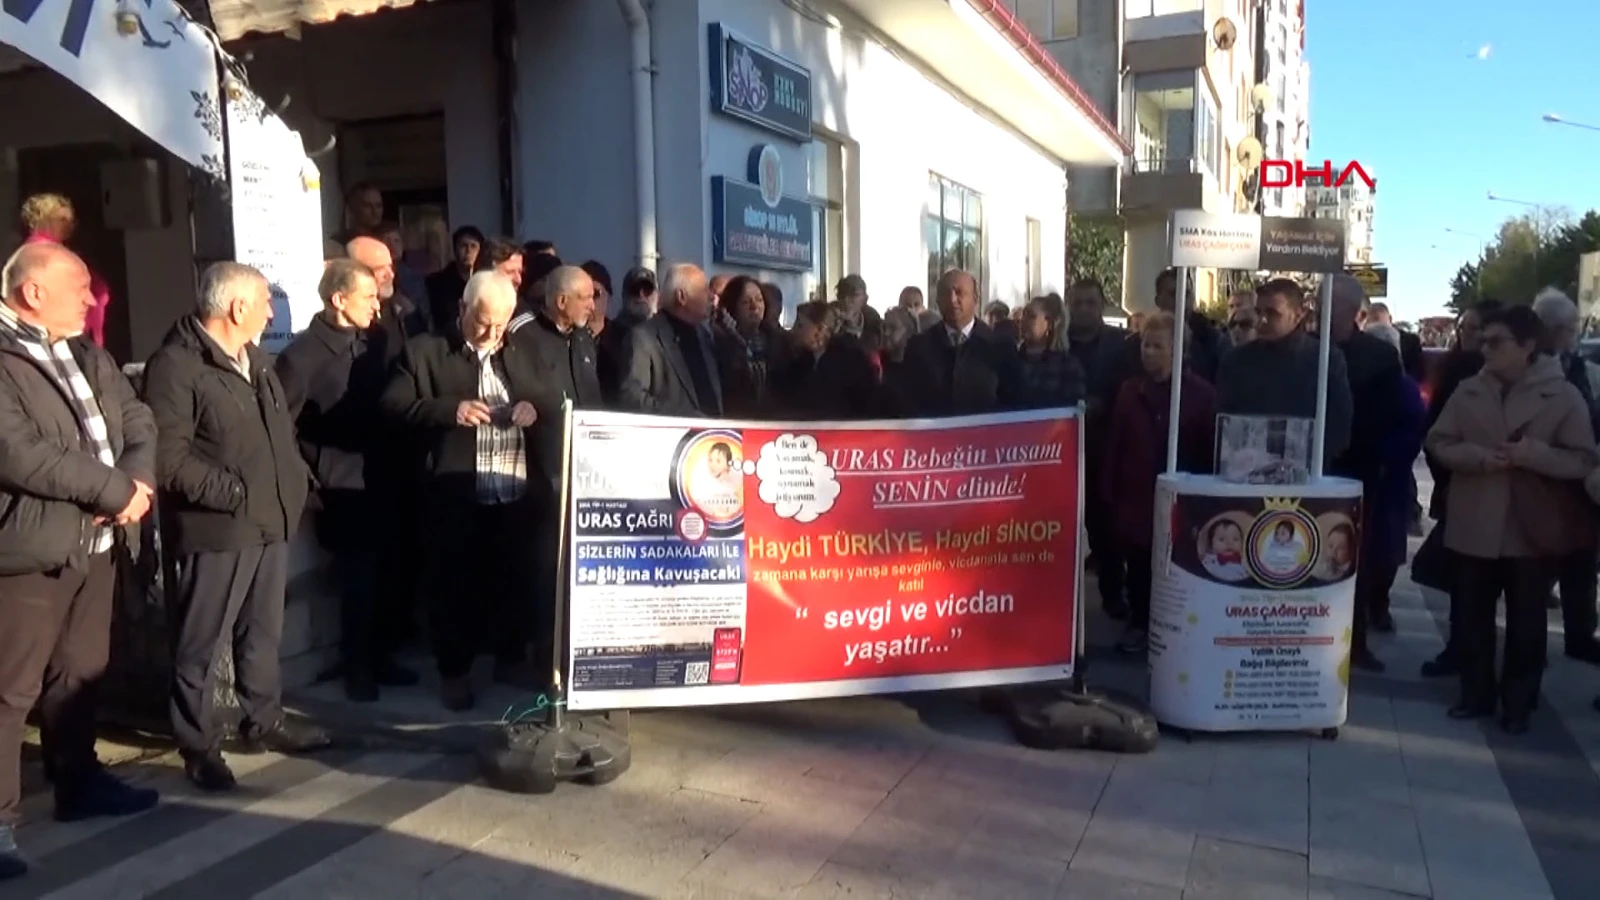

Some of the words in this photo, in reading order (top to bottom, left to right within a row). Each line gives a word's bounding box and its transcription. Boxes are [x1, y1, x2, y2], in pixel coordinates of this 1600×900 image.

[1180, 227, 1199, 236] SMA
[832, 449, 893, 470] URAS
[902, 446, 986, 469] Bebeğin
[995, 442, 1062, 464] yaşamı
[873, 475, 950, 502] SENİN
[956, 473, 1026, 499] elinde!
[578, 512, 621, 528] URAS
[626, 508, 673, 532] ÇAĞRI
[578, 543, 636, 558] SİZLERİN
[640, 544, 720, 557] SADAKALARI
[722, 543, 740, 557] İLE
[749, 536, 811, 563] Haydi
[819, 529, 929, 556] TÜRKİYE,
[936, 525, 990, 551] Haydi
[996, 520, 1061, 544] SİNOP
[578, 567, 650, 584] Sağlığına
[753, 569, 807, 582] zamana
[810, 567, 844, 581] karşı
[1012, 552, 1035, 563] sen
[1039, 551, 1055, 562] de
[898, 579, 923, 593] katıl
[824, 601, 891, 630] sevgi
[901, 604, 928, 621] ve
[935, 591, 1014, 615] vicdan
[1225, 607, 1259, 617] URAS
